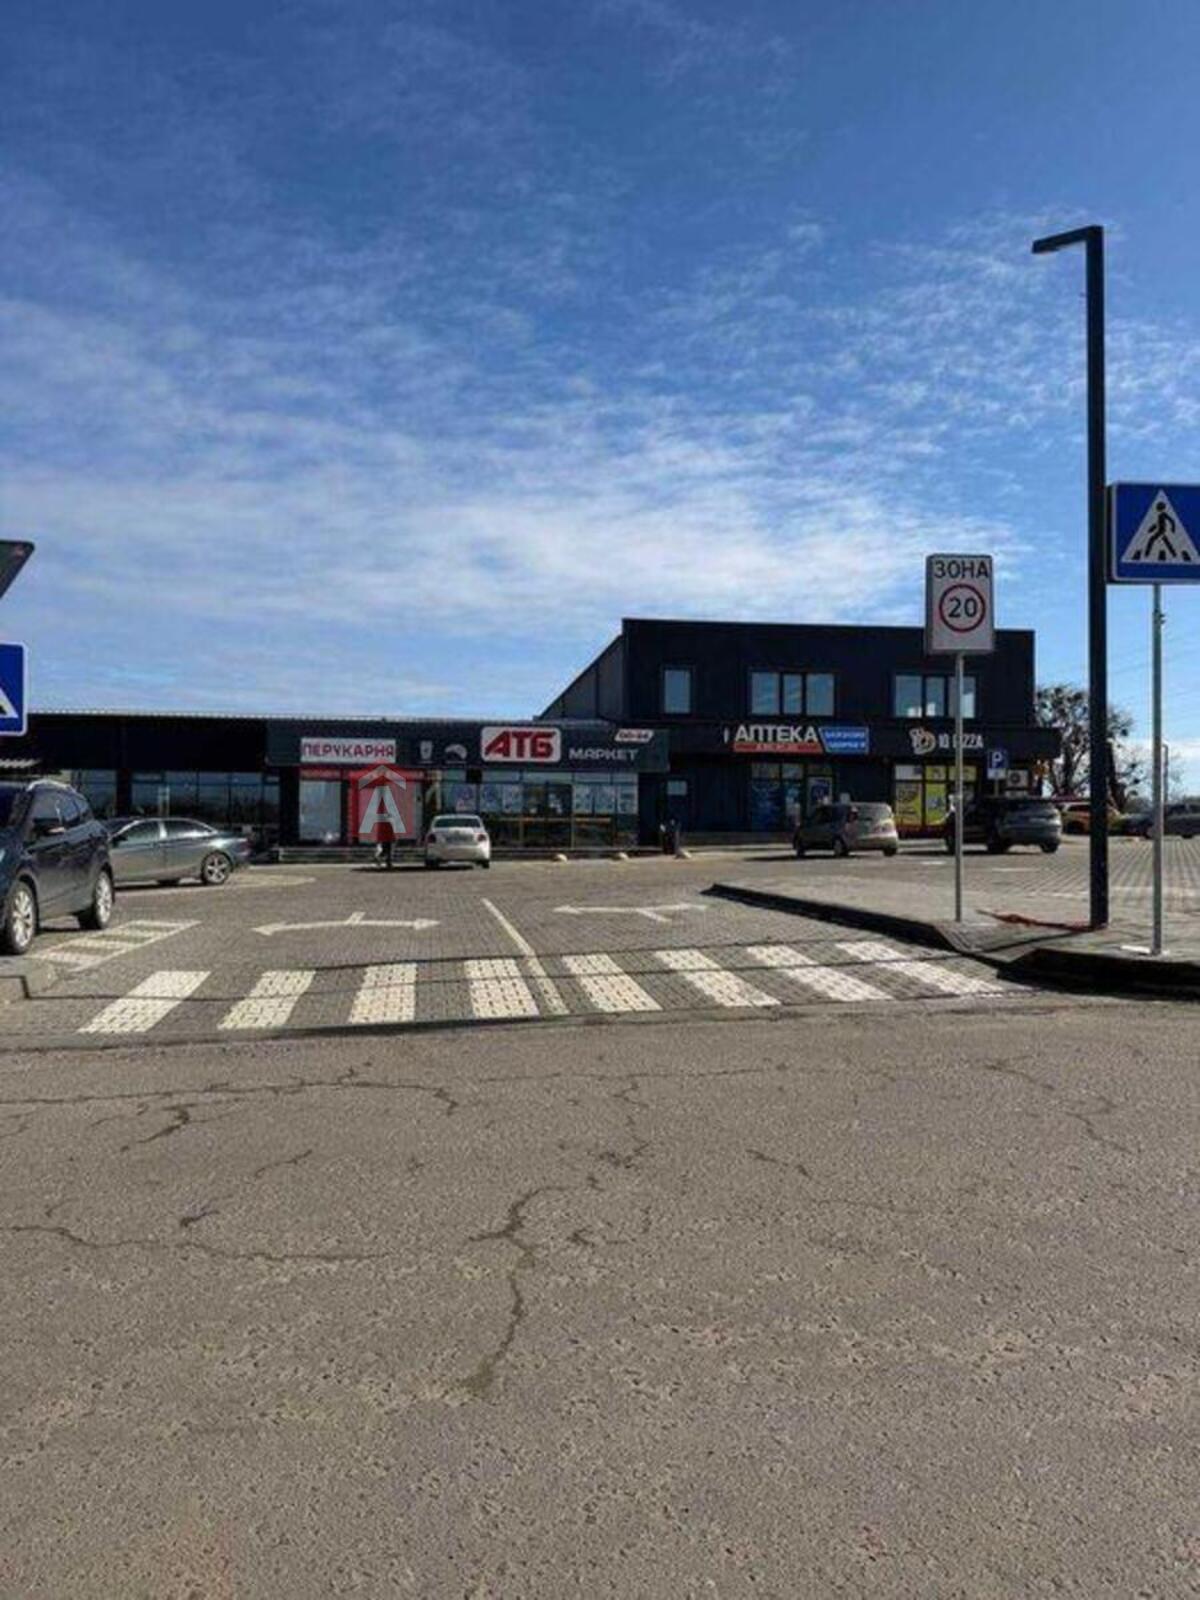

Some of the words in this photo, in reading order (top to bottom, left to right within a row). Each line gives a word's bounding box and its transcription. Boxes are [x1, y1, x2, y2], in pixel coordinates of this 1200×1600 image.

[934, 560, 989, 579] ЗОНА
[948, 597, 978, 618] 20
[735, 725, 819, 743] АПТЕКА
[952, 733, 984, 748] PZZA
[302, 743, 395, 758] ПЕРУКАРНЯ
[484, 730, 557, 759] АТБ
[568, 748, 639, 761] МАРКЕТ
